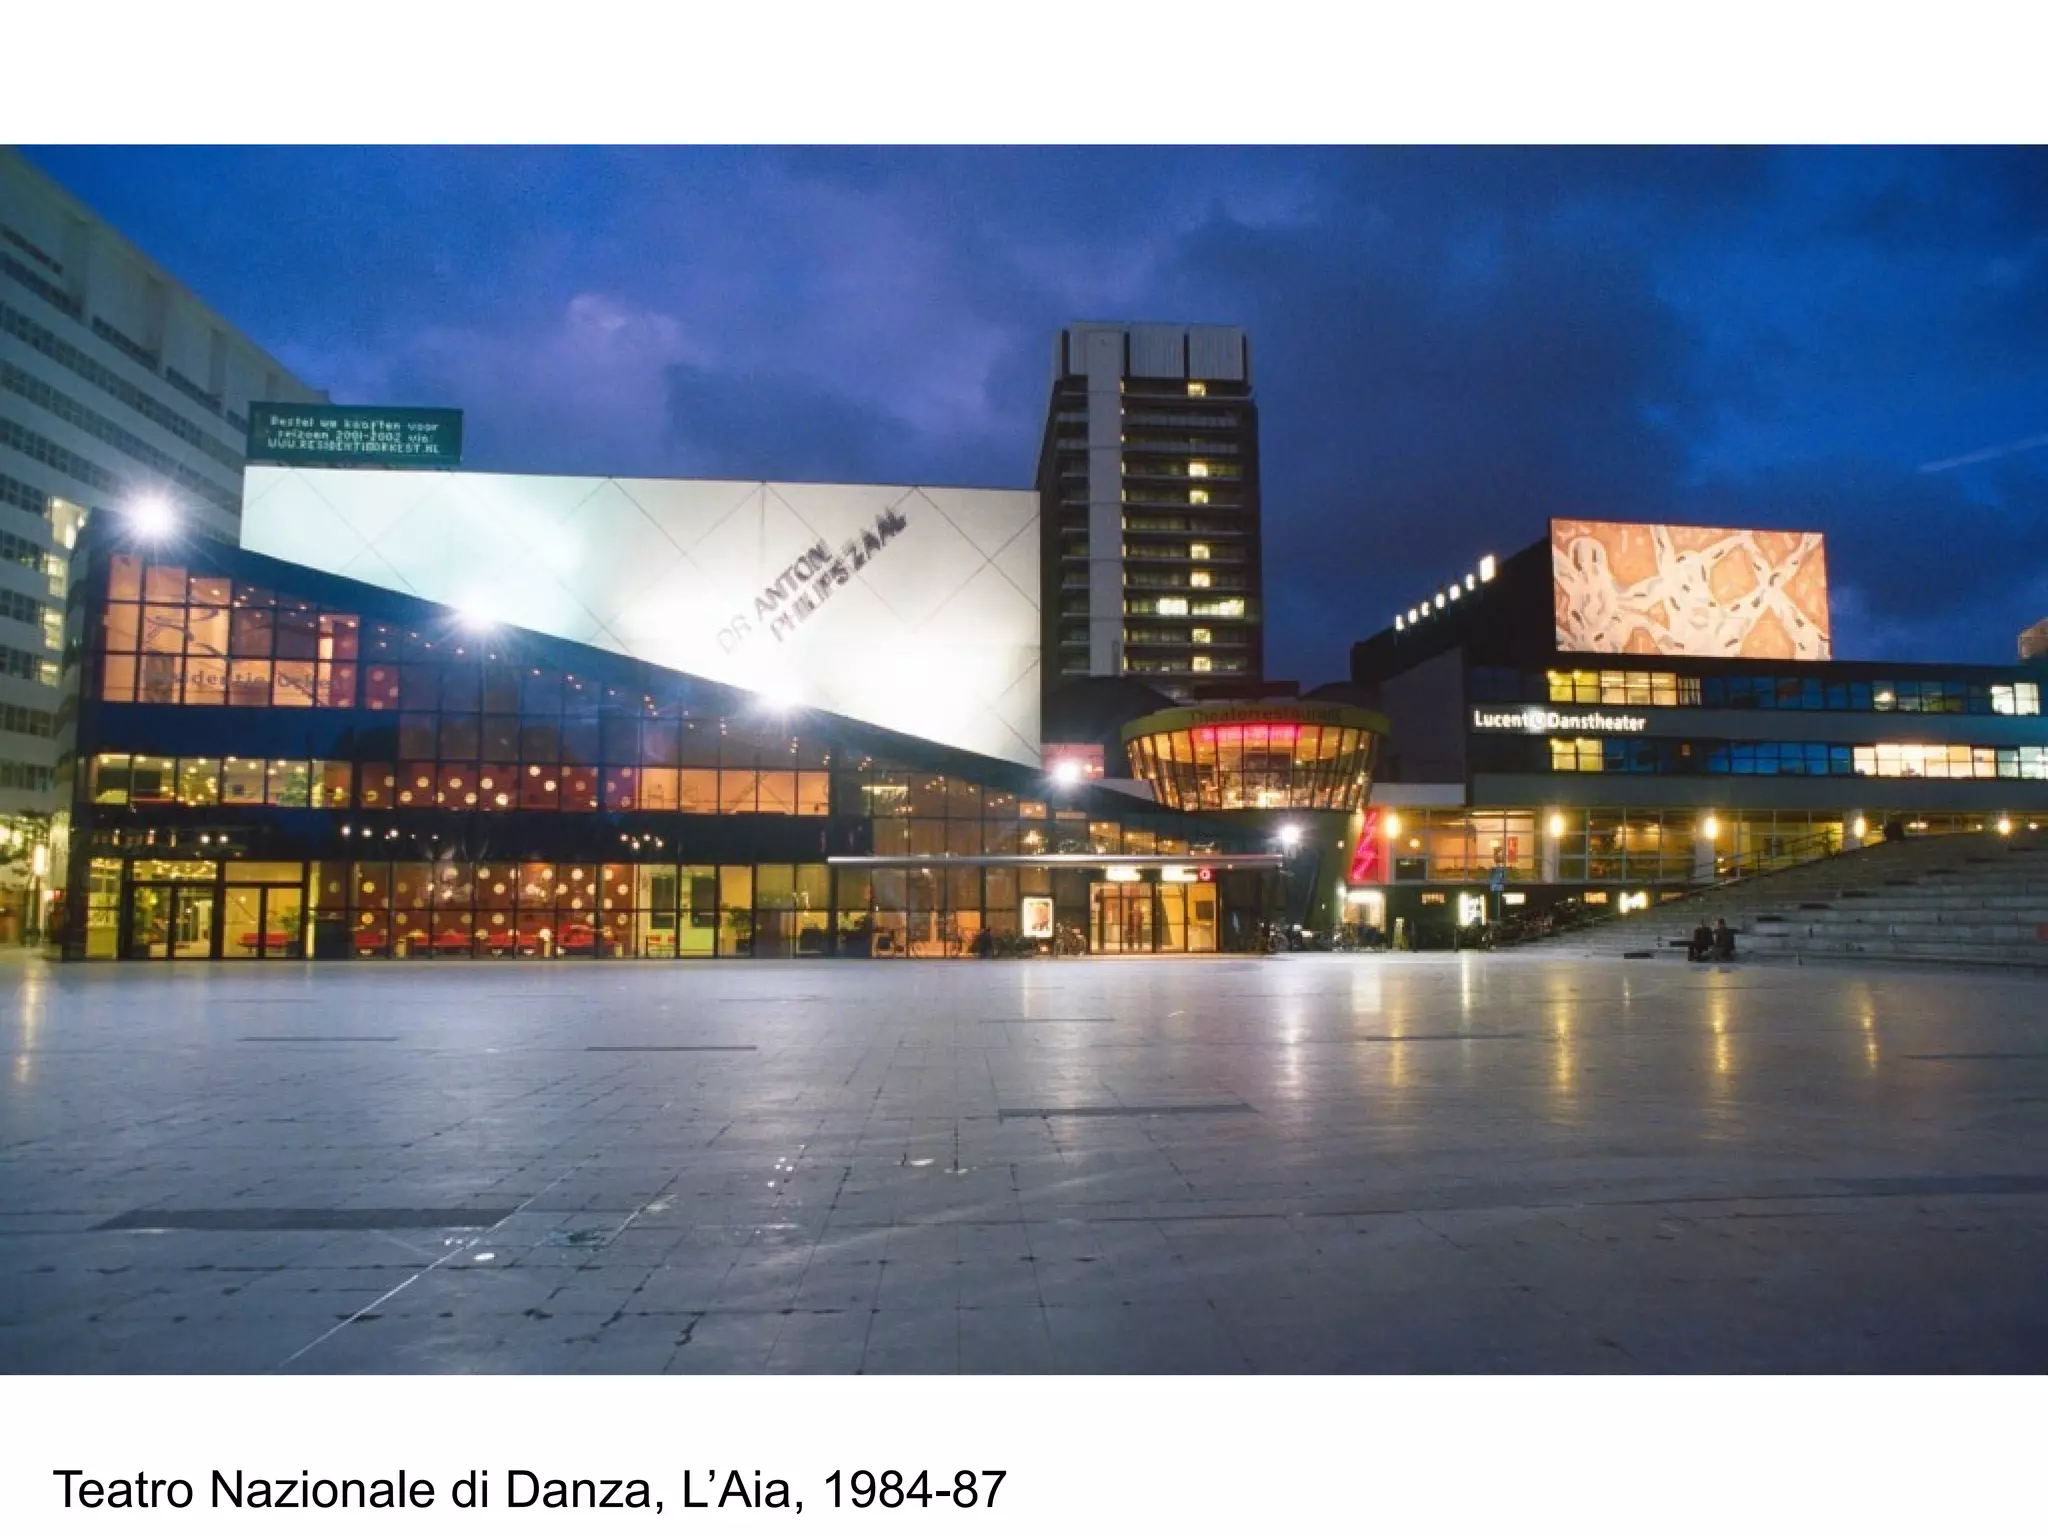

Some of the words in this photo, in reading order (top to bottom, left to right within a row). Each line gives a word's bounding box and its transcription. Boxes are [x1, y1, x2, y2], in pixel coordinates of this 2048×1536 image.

[716, 613, 754, 655] DR
[754, 537, 832, 621] ANTON
[1474, 710, 1529, 729] Lucent
[1547, 711, 1647, 732] Danstheater
